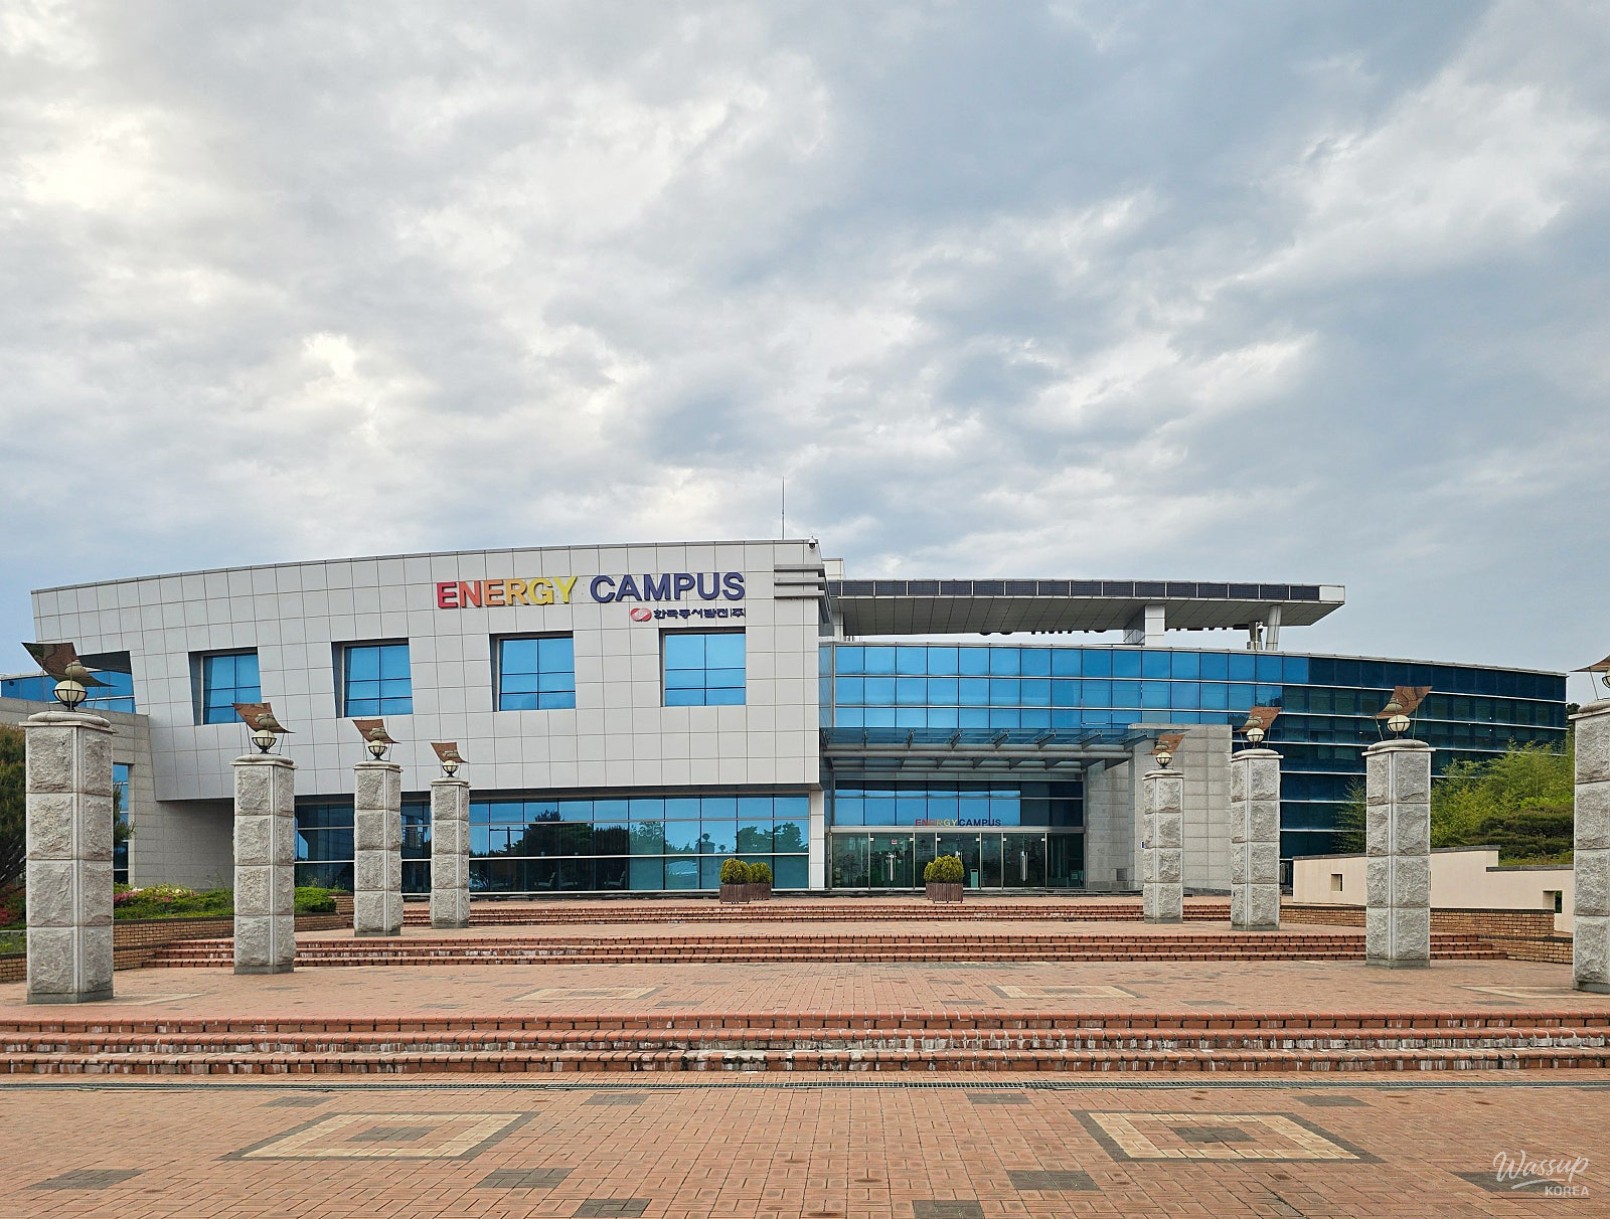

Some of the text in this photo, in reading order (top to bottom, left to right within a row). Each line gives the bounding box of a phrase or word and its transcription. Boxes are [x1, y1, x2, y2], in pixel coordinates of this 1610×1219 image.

[436, 571, 746, 609] ENERGY CAMPUS
[915, 818, 1002, 827] ENERGY CAMPUS
